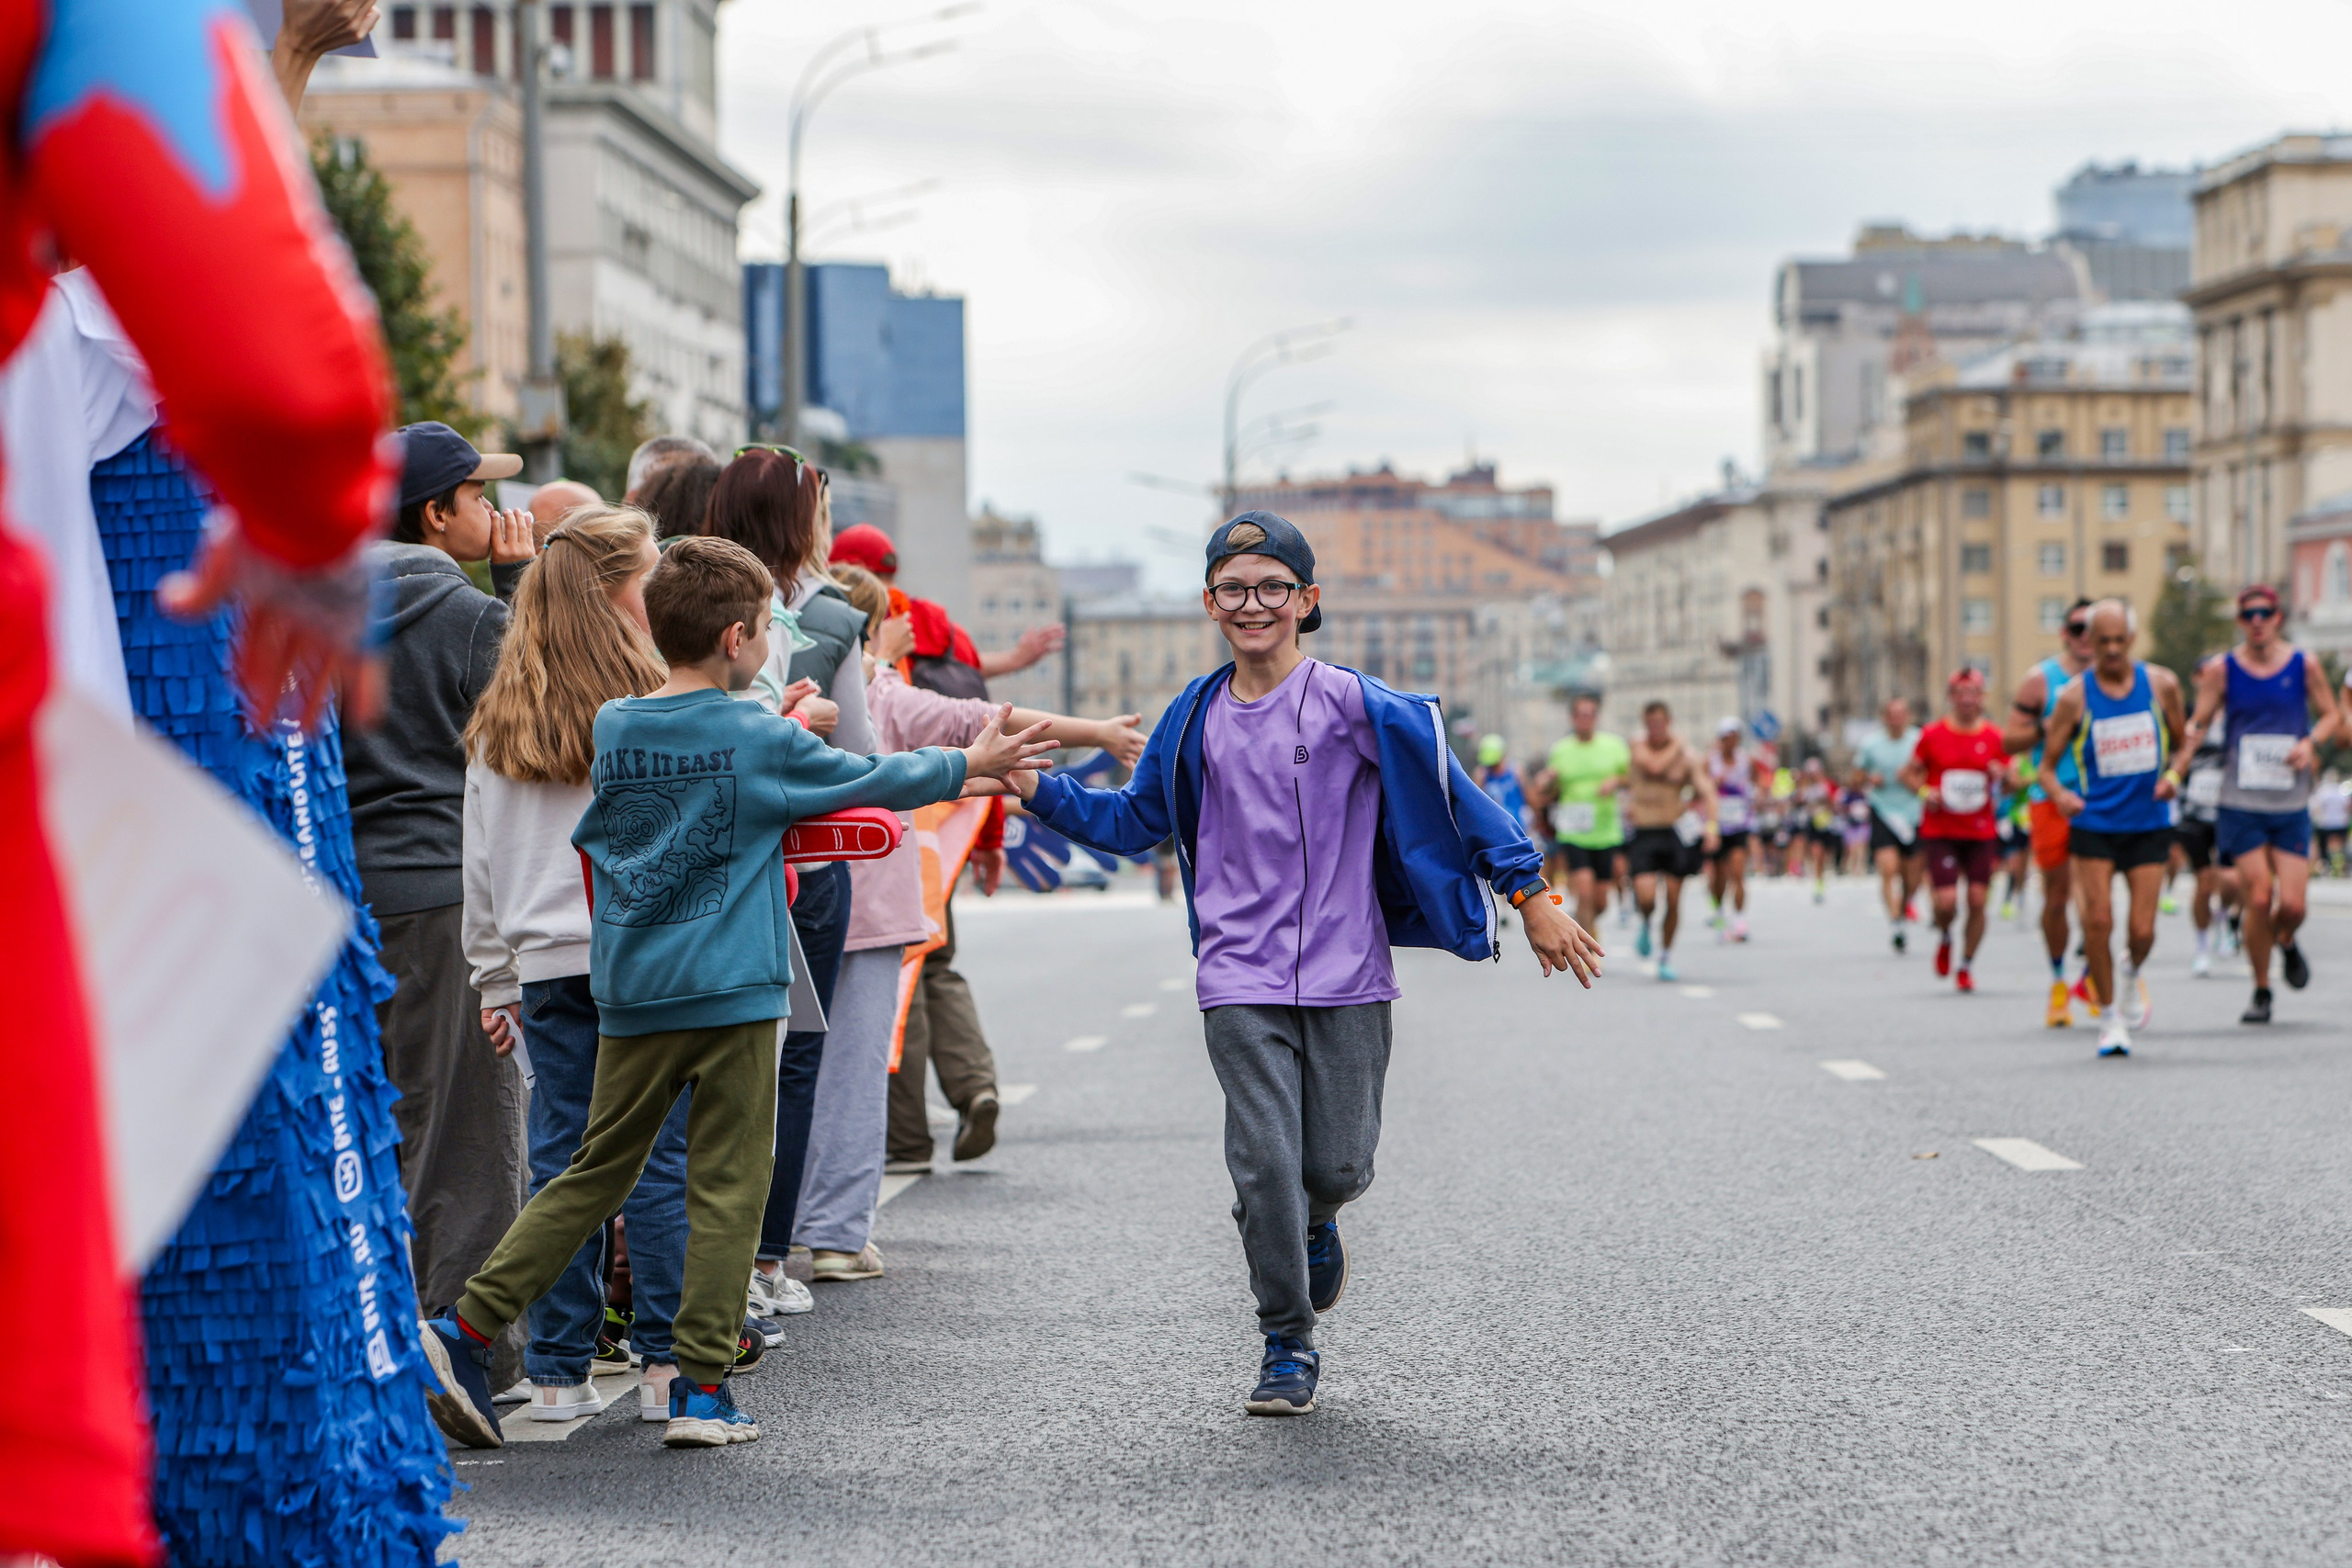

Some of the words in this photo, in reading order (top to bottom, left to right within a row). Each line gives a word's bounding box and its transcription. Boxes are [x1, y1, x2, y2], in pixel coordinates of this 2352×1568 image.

[599, 747, 647, 784] TAKE
[651, 751, 673, 777] IT
[676, 747, 736, 775] EASY
